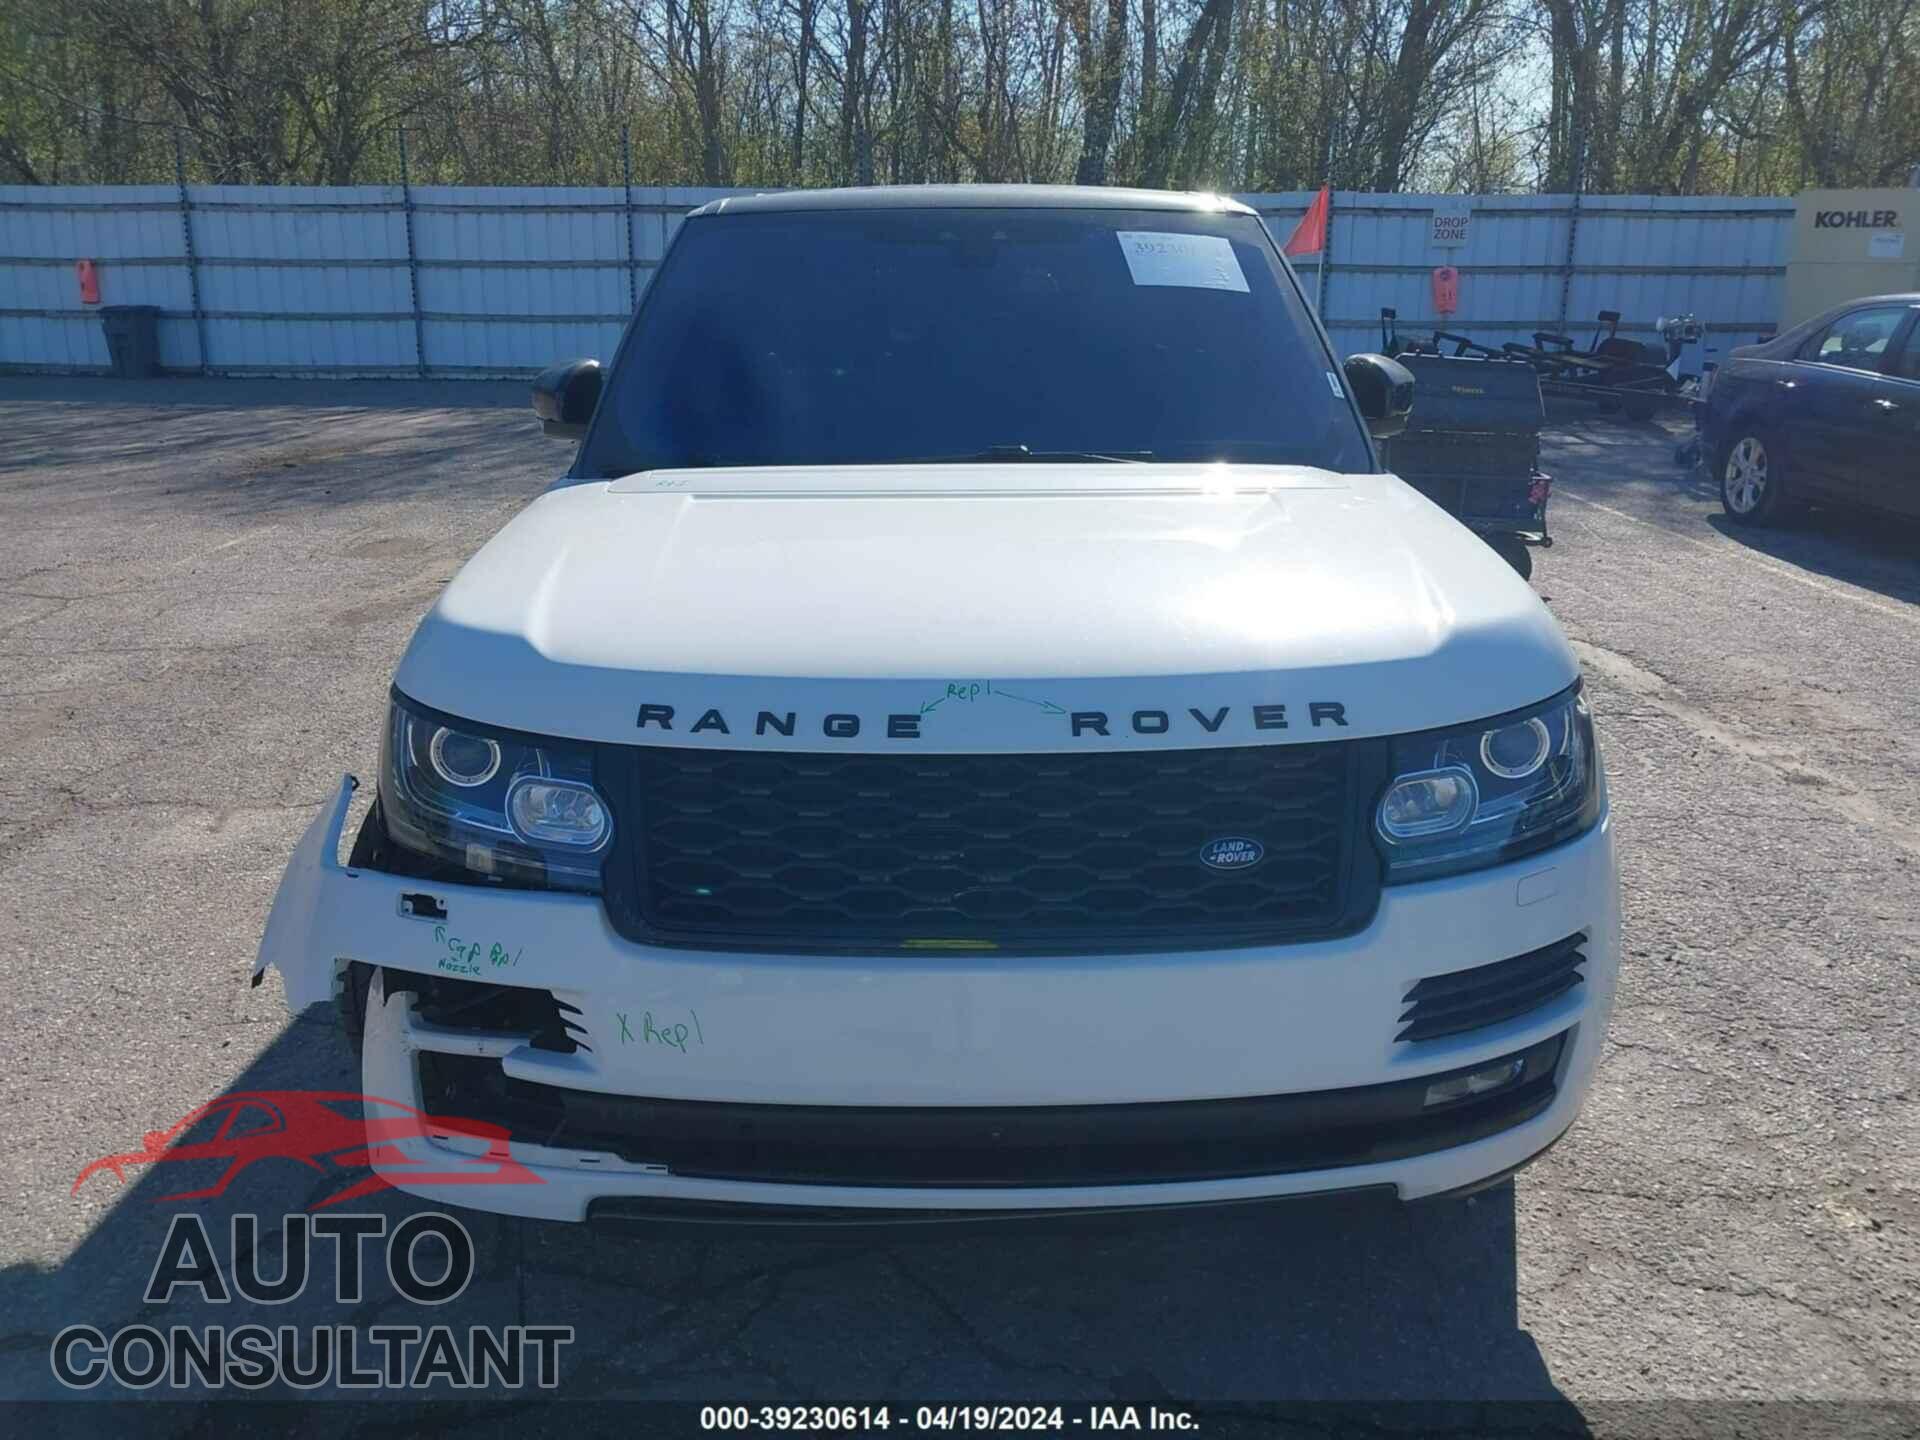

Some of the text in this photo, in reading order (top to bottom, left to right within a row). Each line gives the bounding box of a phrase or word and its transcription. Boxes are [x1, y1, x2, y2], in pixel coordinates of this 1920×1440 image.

[1433, 216, 1469, 228] DROP
[1814, 209, 1897, 228] KOHLER
[1433, 229, 1468, 240] ZONE
[636, 702, 1349, 739] RANGE ROVER
[1212, 841, 1245, 853] LAND
[1216, 850, 1256, 863] ROVER
